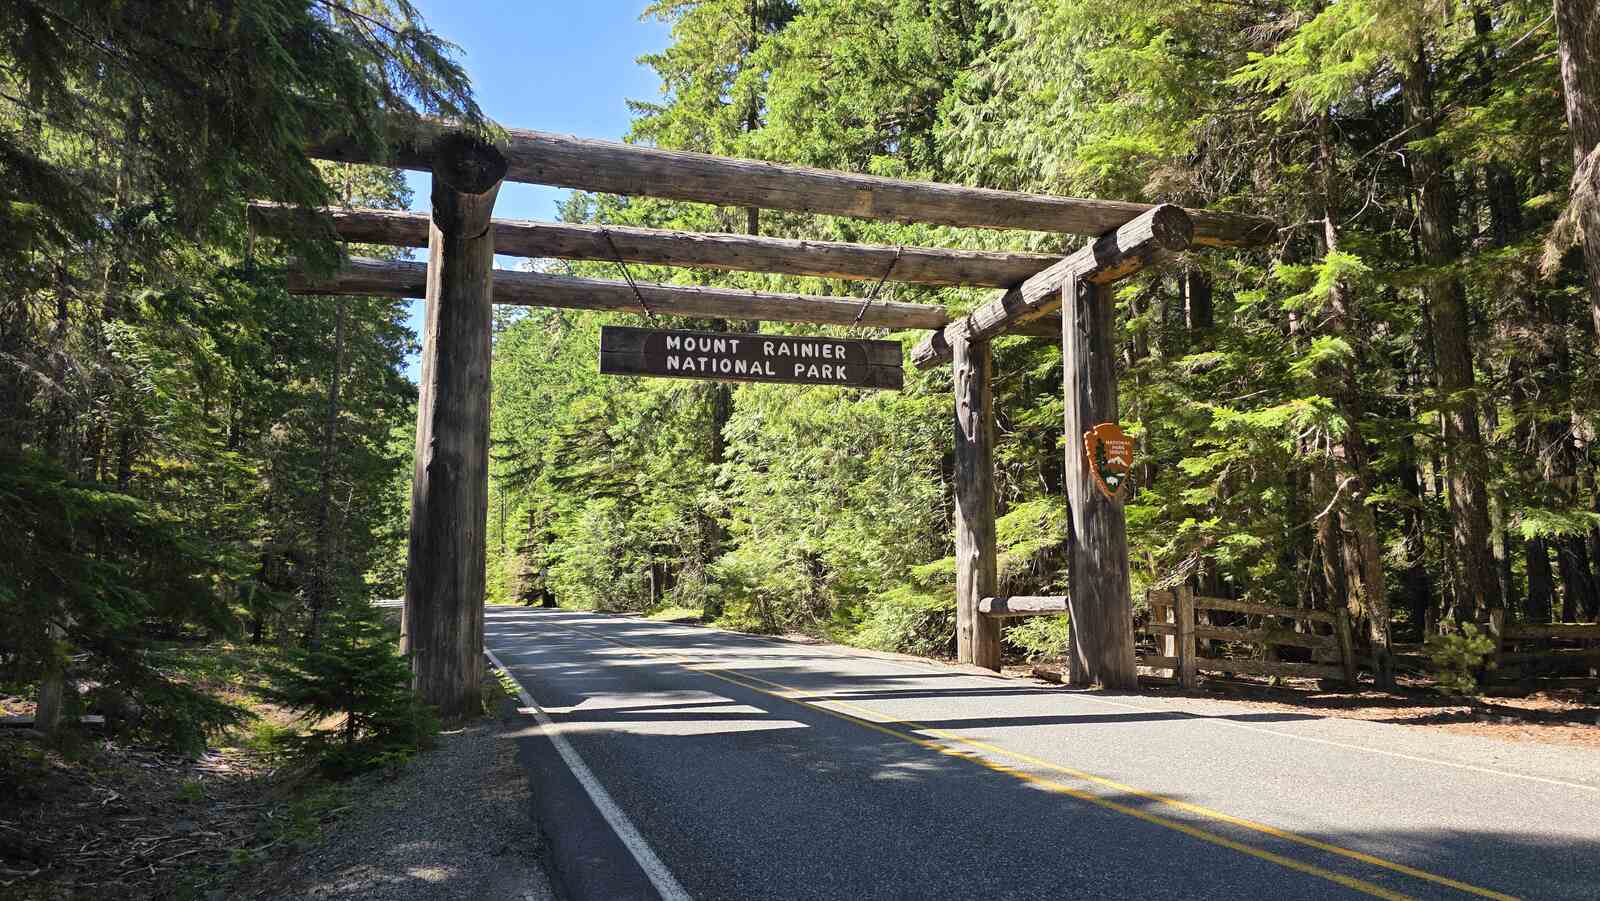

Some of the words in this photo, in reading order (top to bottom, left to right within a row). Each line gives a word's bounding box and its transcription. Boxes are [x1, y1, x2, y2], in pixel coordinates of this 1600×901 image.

[666, 336, 740, 354] MOUNT
[763, 341, 847, 359] RAINIER
[666, 355, 776, 376] NATIONAL
[794, 363, 848, 380] PARK
